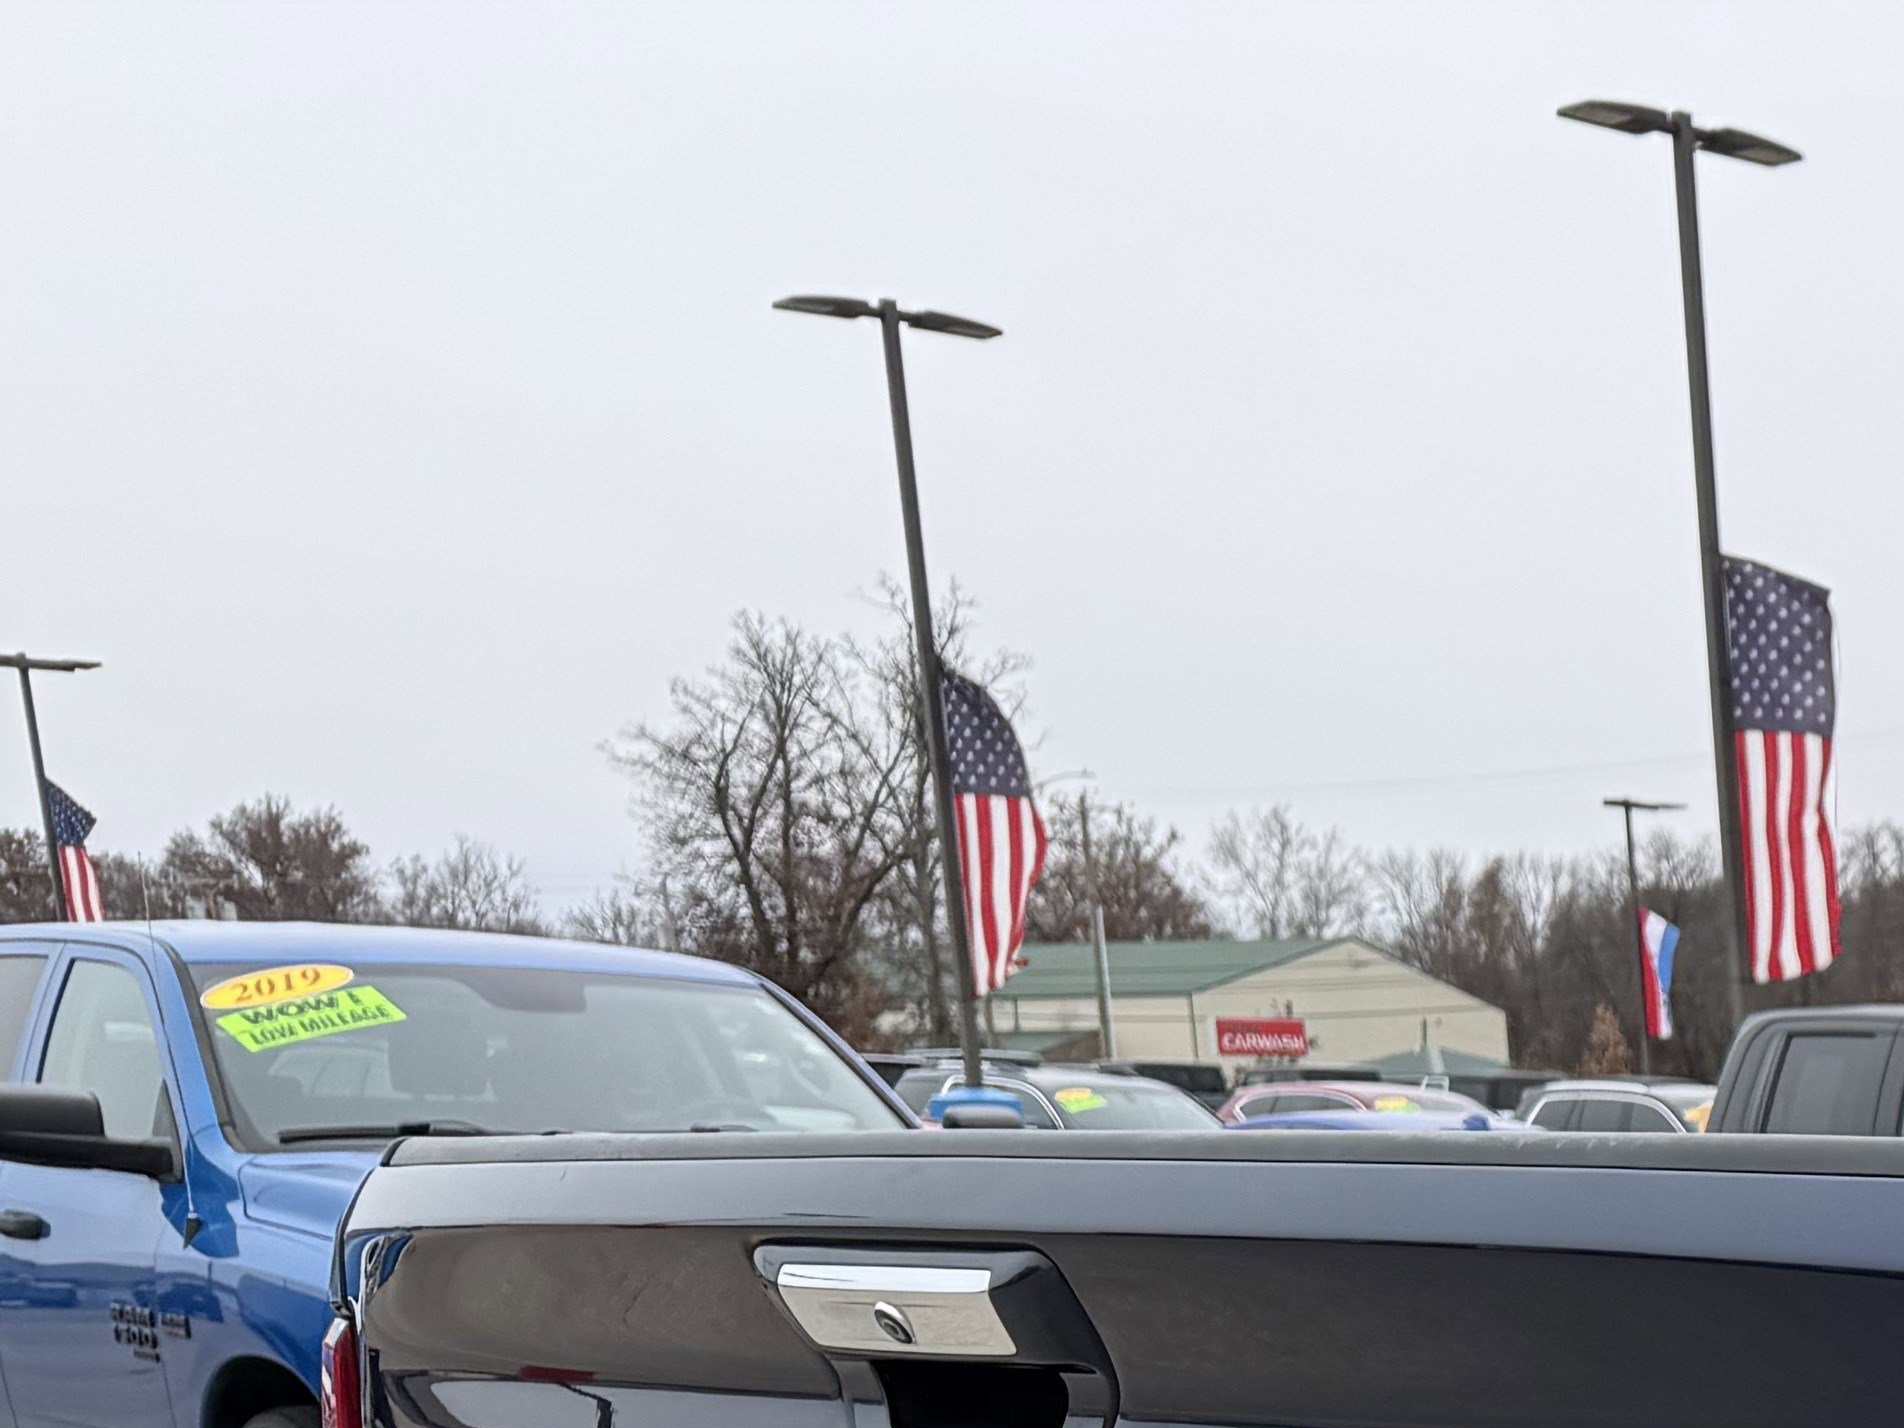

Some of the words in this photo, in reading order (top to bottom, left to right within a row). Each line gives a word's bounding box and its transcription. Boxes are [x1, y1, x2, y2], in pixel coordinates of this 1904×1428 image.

[231, 967, 320, 1003] 2019
[240, 993, 338, 1025] WOW
[300, 1004, 390, 1033] MILEAGE
